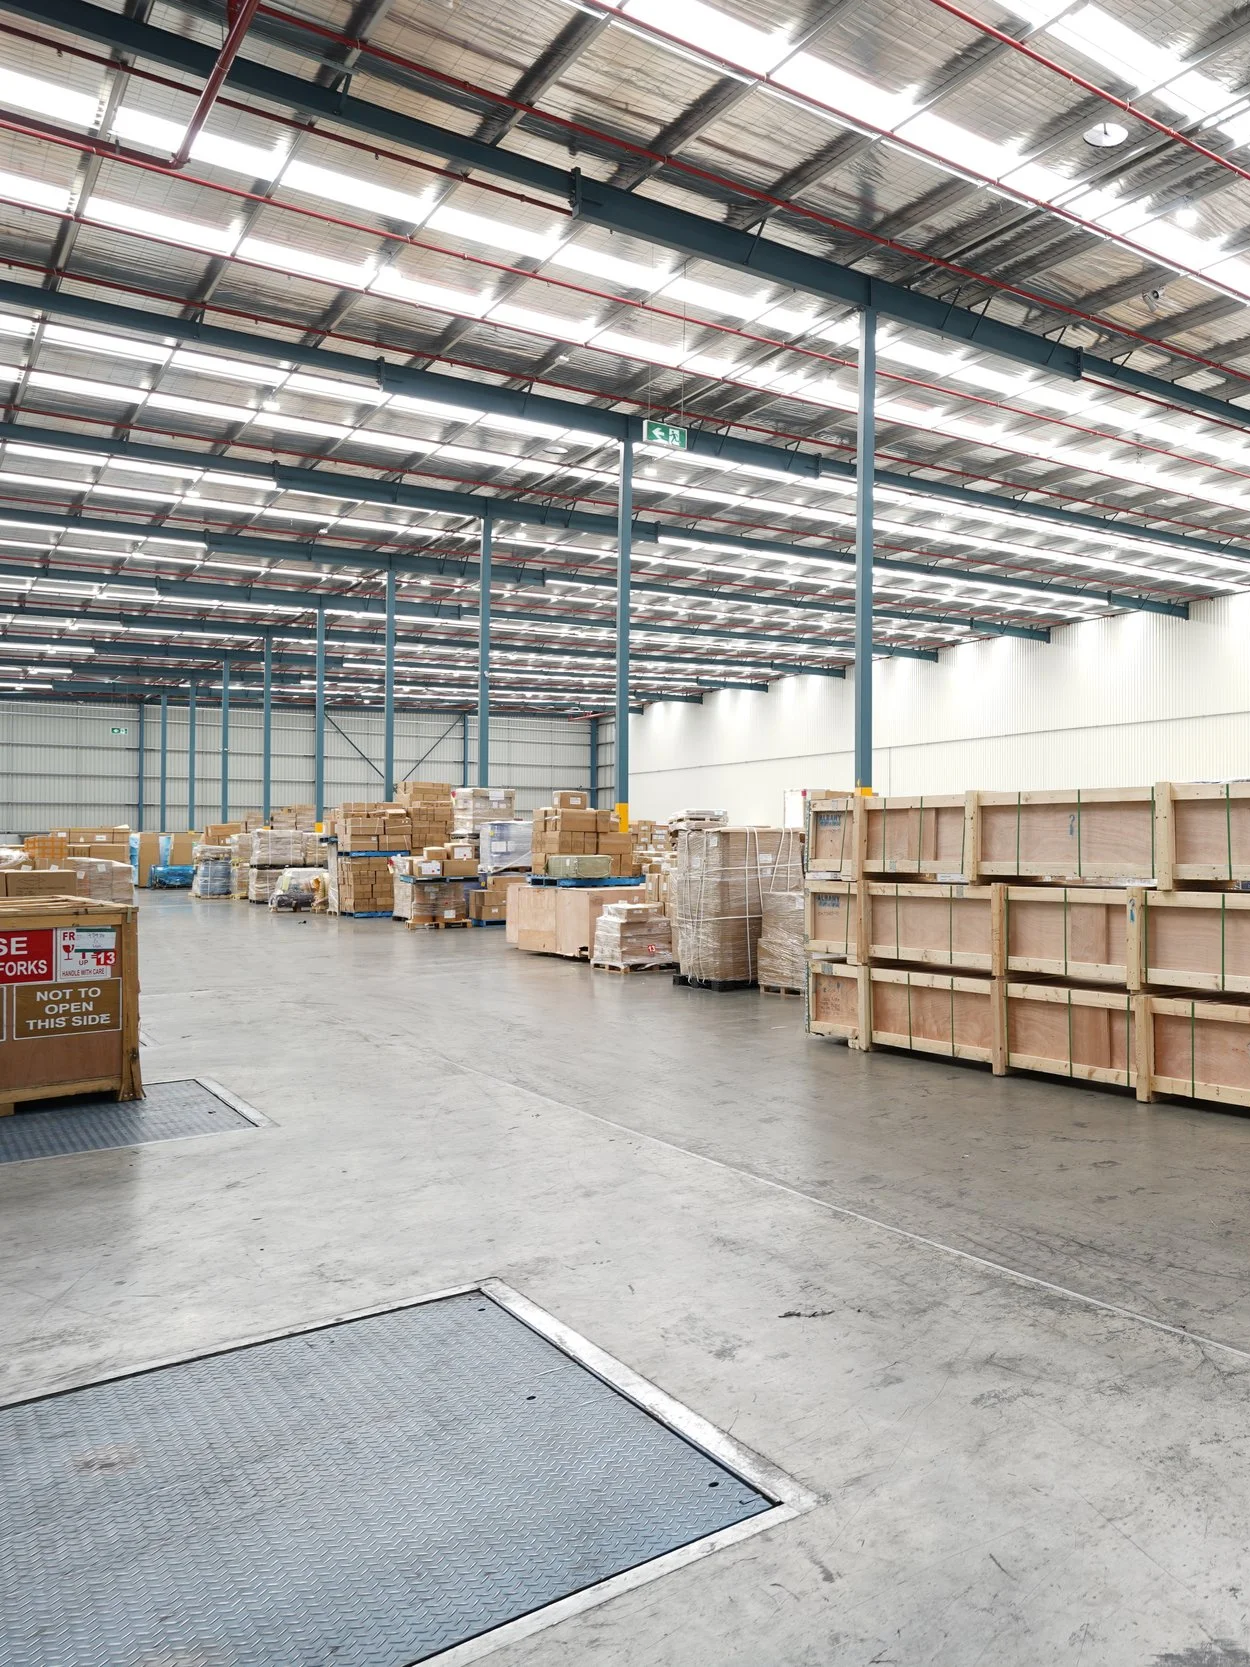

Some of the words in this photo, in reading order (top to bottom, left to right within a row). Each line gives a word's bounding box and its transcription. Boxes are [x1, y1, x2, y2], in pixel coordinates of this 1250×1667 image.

[97, 951, 116, 965] 13
[61, 969, 80, 977] HANDLE
[80, 968, 93, 976] WITH
[92, 967, 105, 975] CARE
[36, 989, 73, 1002] NOT
[78, 987, 101, 999] TO
[45, 1001, 94, 1015] OPEN
[26, 1017, 67, 1030] THIS
[71, 1014, 111, 1026] SIDE
